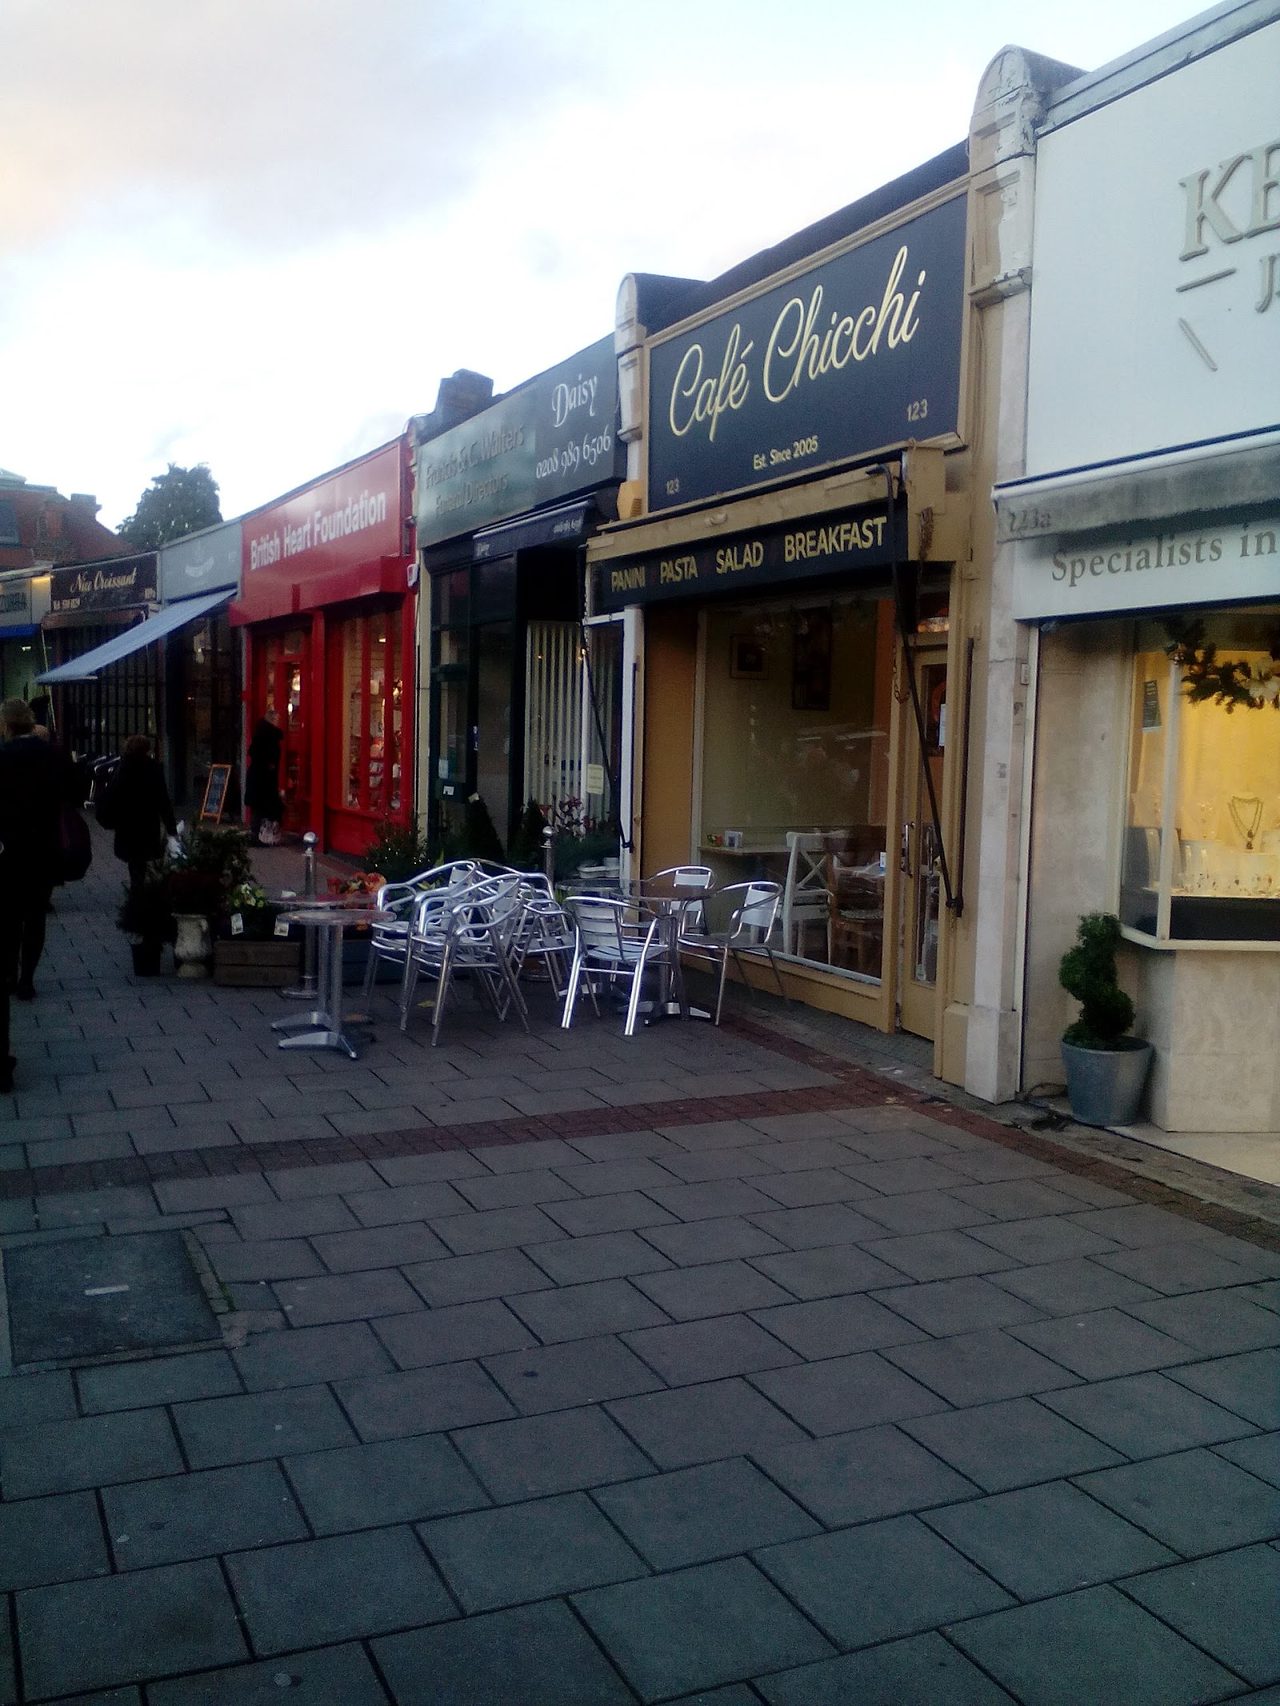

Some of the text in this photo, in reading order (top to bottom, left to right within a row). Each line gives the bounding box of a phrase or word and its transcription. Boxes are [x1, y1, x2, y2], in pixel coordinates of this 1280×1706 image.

[670, 245, 926, 442] Café Chicchi
[552, 373, 598, 428] Daisy
[906, 398, 928, 422] 123
[536, 424, 612, 479] 0208 989 6506
[769, 446, 792, 466] Since
[793, 434, 818, 459] 2005
[251, 530, 280, 570] British
[283, 520, 311, 558] Heart
[314, 489, 387, 546] Foundation
[611, 516, 888, 592] PANINI PASTA SALAD BREAKFAST
[1051, 521, 1278, 587] Specialists in
